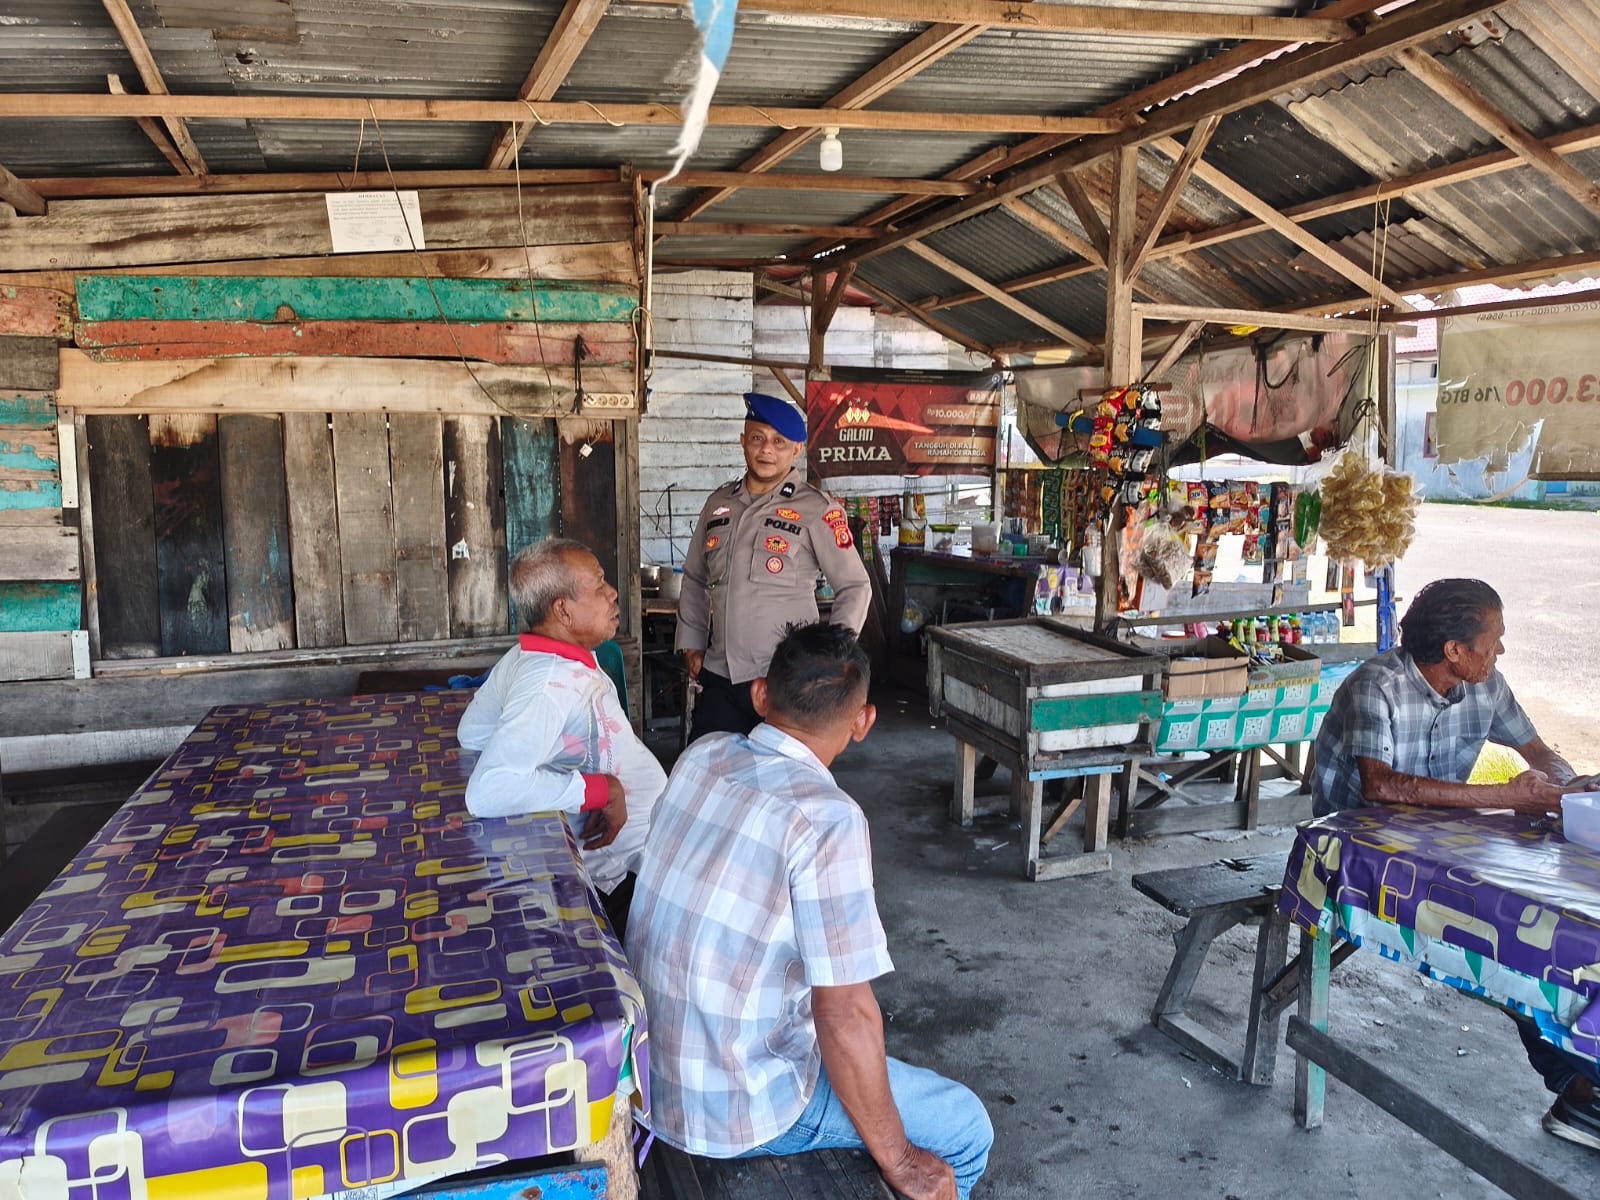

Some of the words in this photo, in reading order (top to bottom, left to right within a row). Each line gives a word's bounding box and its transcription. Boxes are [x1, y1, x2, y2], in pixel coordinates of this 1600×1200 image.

[839, 428, 874, 442] GALAN
[819, 446, 893, 463] PRIMA
[764, 518, 802, 536] POLRI
